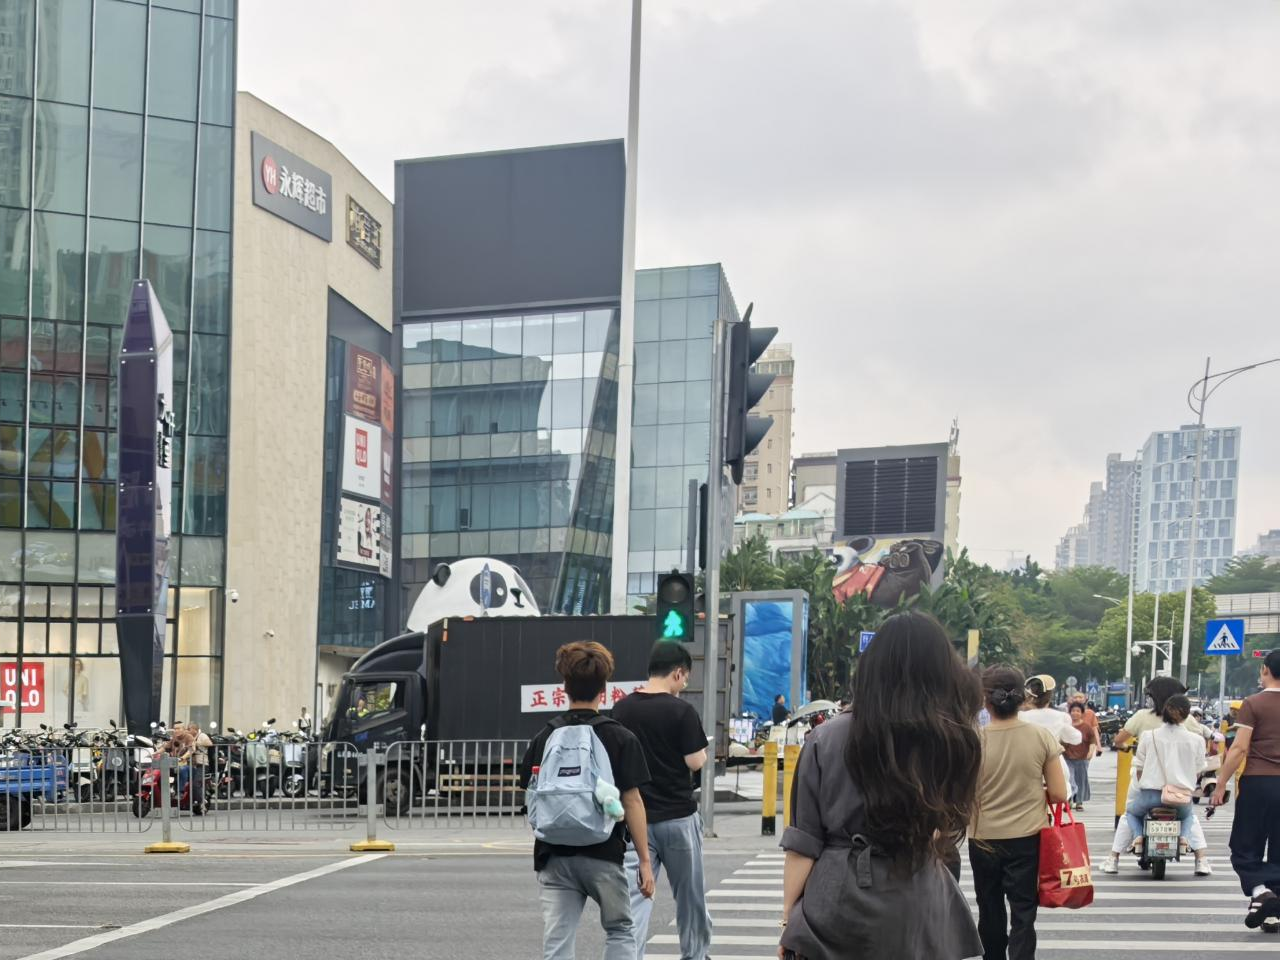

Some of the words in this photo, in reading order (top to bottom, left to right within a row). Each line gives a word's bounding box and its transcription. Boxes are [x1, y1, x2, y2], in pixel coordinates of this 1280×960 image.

[279, 165, 327, 216] 永辉超市
[4, 668, 37, 686] UNI
